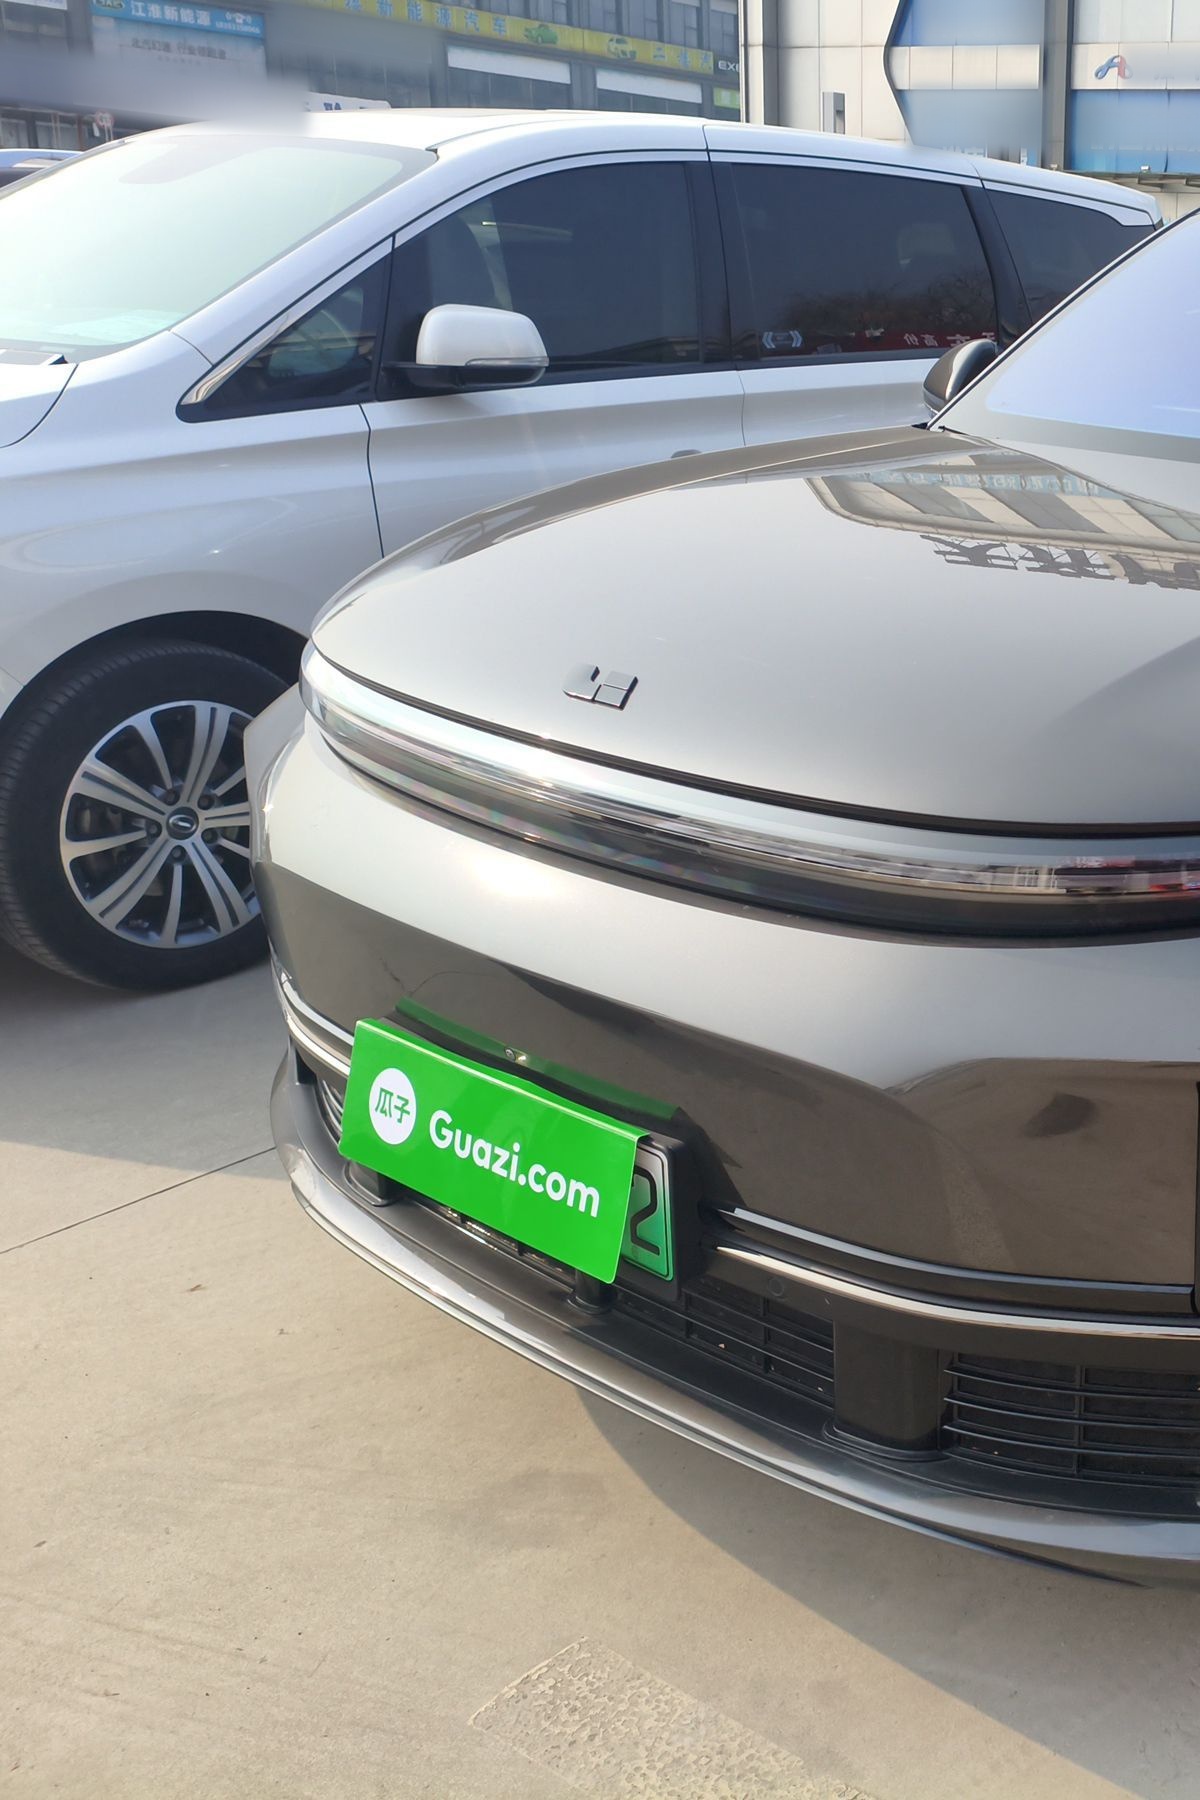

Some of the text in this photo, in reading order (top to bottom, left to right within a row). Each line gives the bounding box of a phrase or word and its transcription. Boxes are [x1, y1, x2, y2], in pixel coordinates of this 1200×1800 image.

[131, 1, 210, 26] 江淮新能源
[375, 1087, 411, 1123] 瓜子
[430, 1110, 600, 1218] Guazi.com
